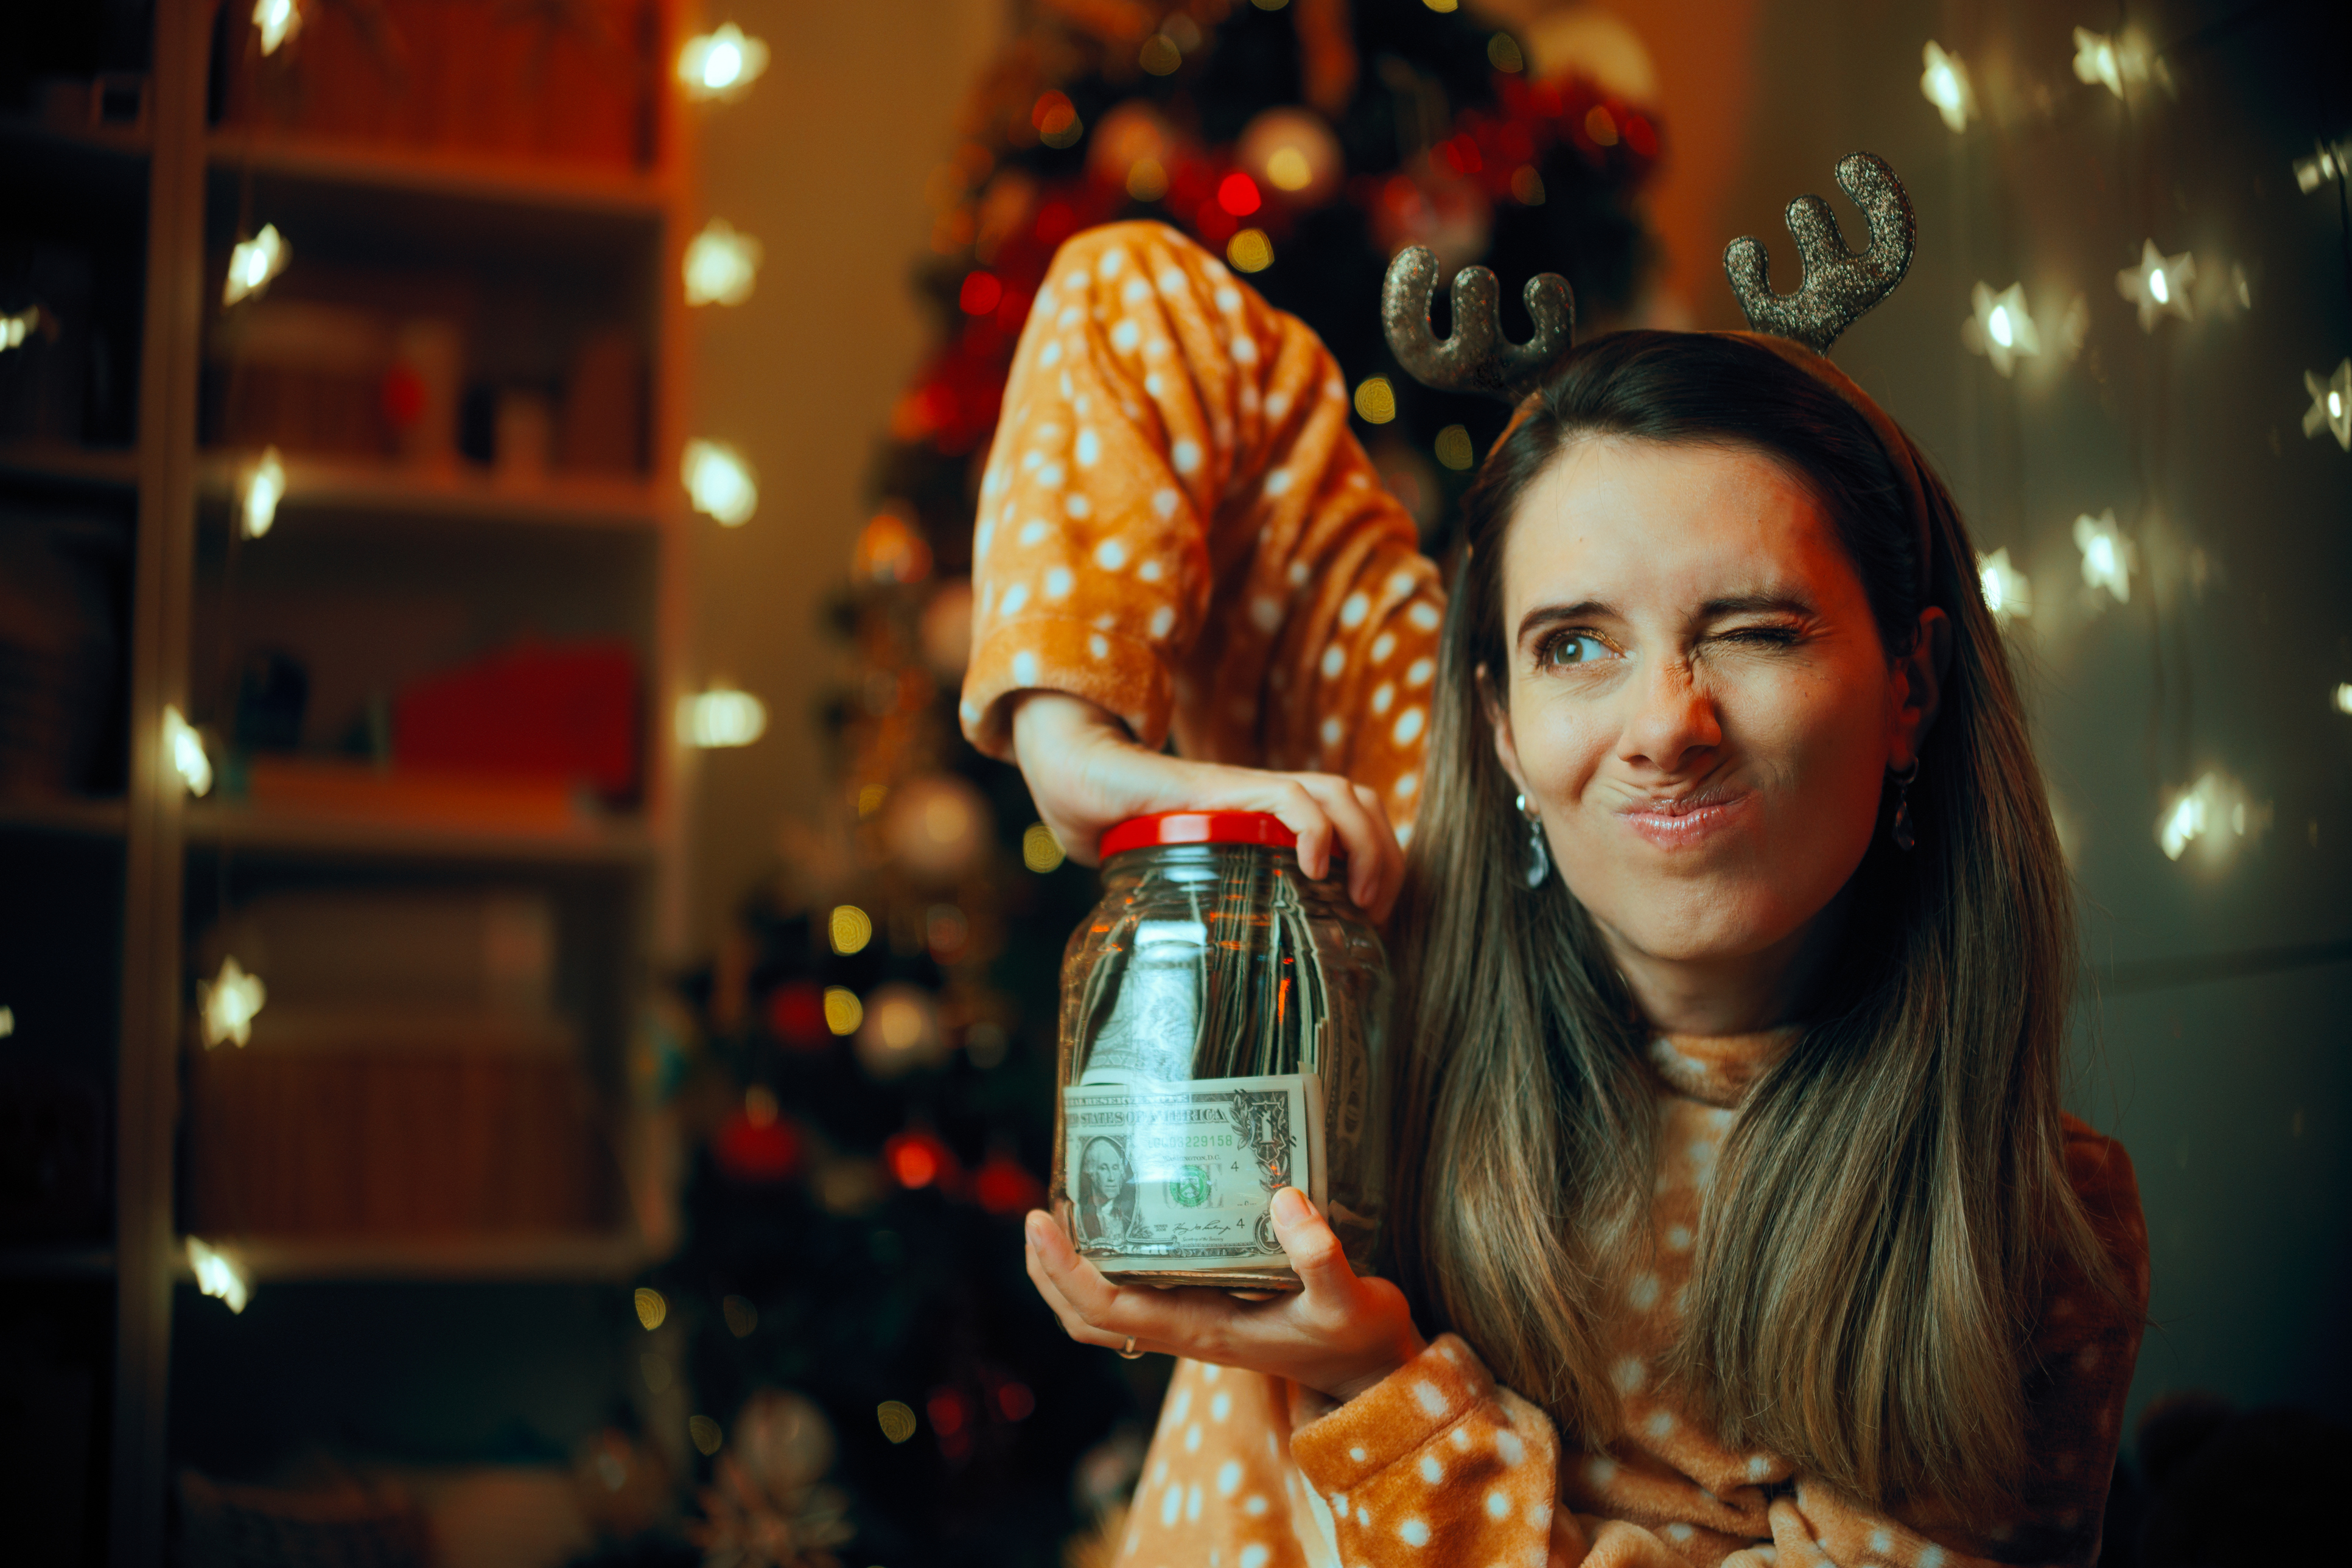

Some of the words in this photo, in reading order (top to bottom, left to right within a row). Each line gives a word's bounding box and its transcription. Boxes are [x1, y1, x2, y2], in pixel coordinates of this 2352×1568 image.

[1080, 1111, 1125, 1128] STATES
[1230, 1161, 1239, 1172] 4
[1236, 1218, 1245, 1229] 4
